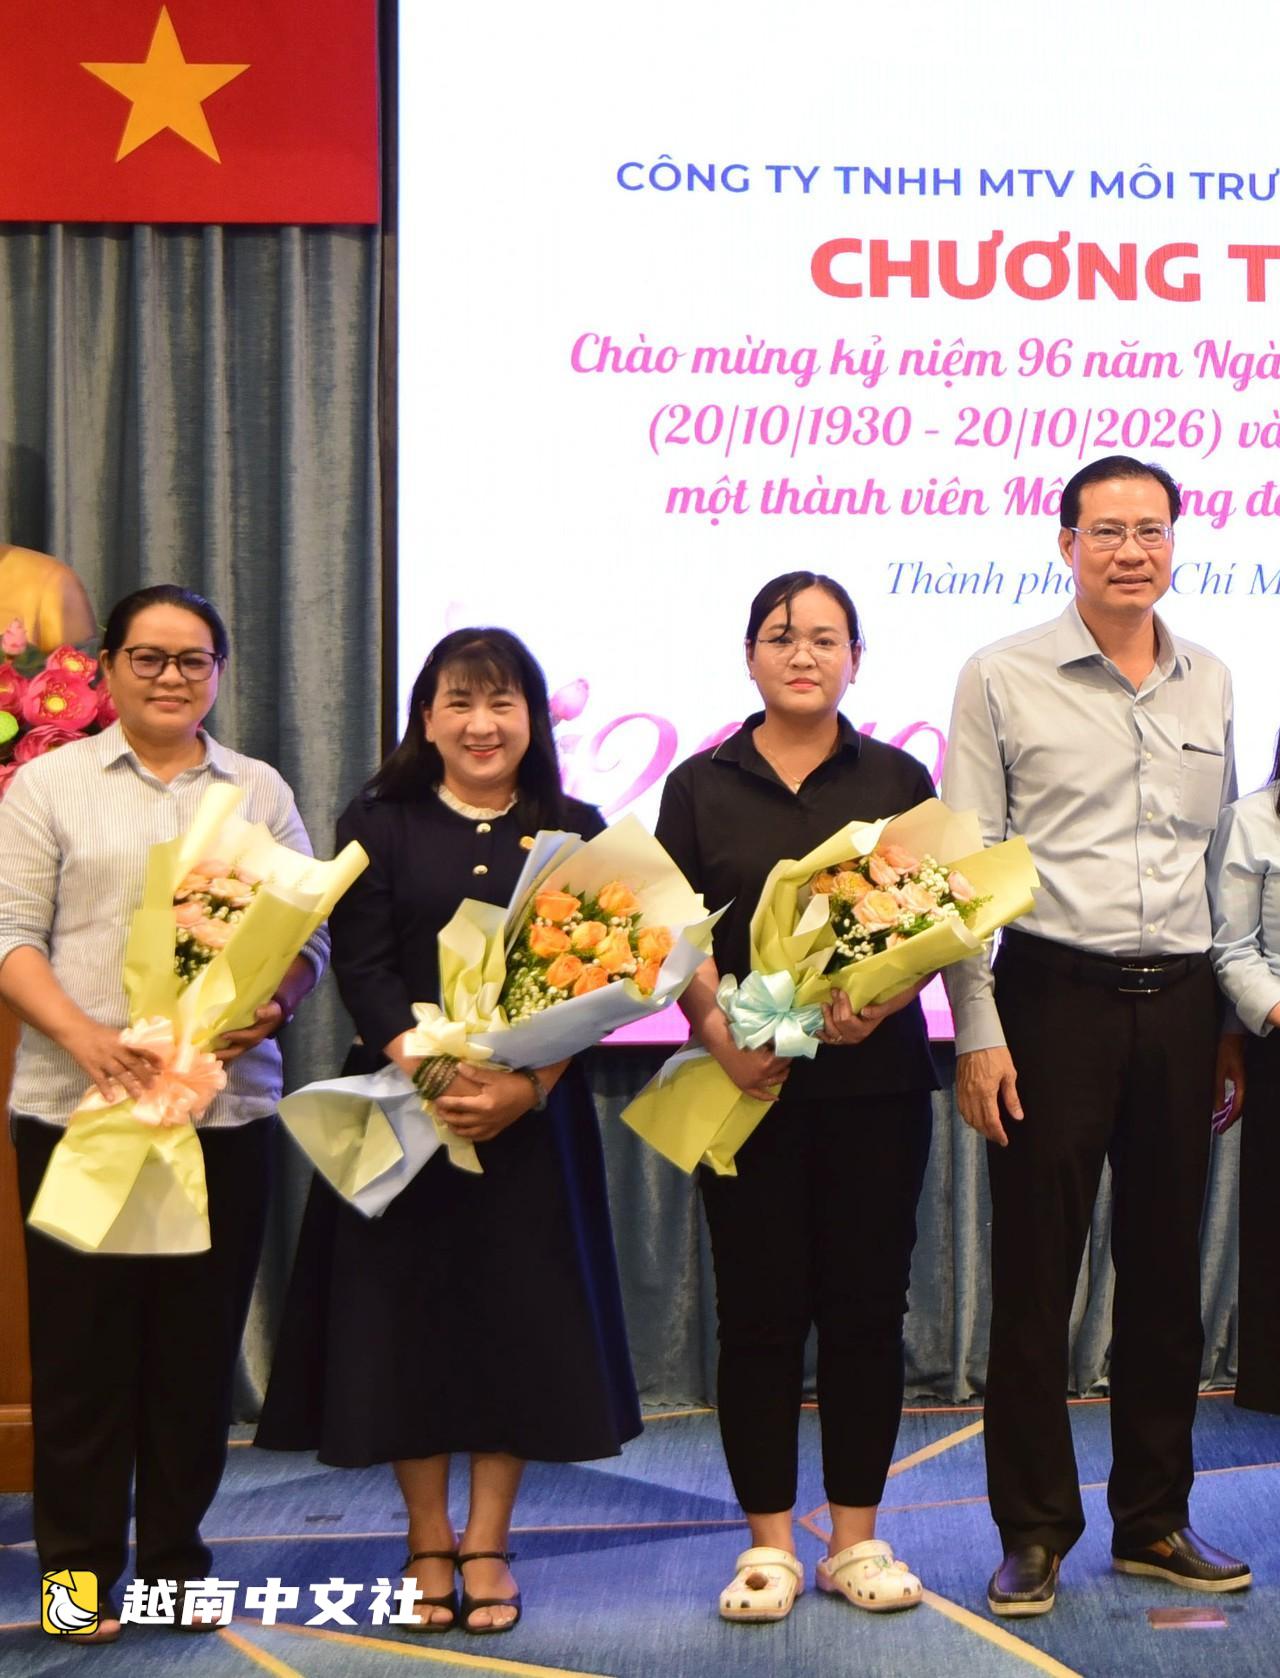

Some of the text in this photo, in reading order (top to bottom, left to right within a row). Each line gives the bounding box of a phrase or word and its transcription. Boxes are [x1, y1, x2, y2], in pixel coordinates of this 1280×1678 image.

[617, 154, 749, 193] CÔNG
[765, 165, 820, 193] TY
[834, 166, 962, 196] TNHH
[980, 169, 1074, 197] MTV
[1090, 164, 1174, 200] MÔI
[810, 230, 1201, 302] CHƯƠNG
[571, 333, 684, 374] Chào
[691, 336, 818, 388] mừng
[830, 335, 887, 389] kỷ
[899, 339, 1006, 388] niệm
[1019, 338, 1075, 377] 96
[1083, 341, 1181, 378] năm
[649, 404, 914, 456] (20/10/1930
[955, 407, 1223, 460] 20/10/2026)
[666, 475, 750, 526] một
[760, 475, 889, 515] thành
[901, 477, 989, 516] viên
[1004, 476, 1065, 516] Mô
[887, 562, 1004, 596] Thành
[1171, 562, 1237, 596] Chí
